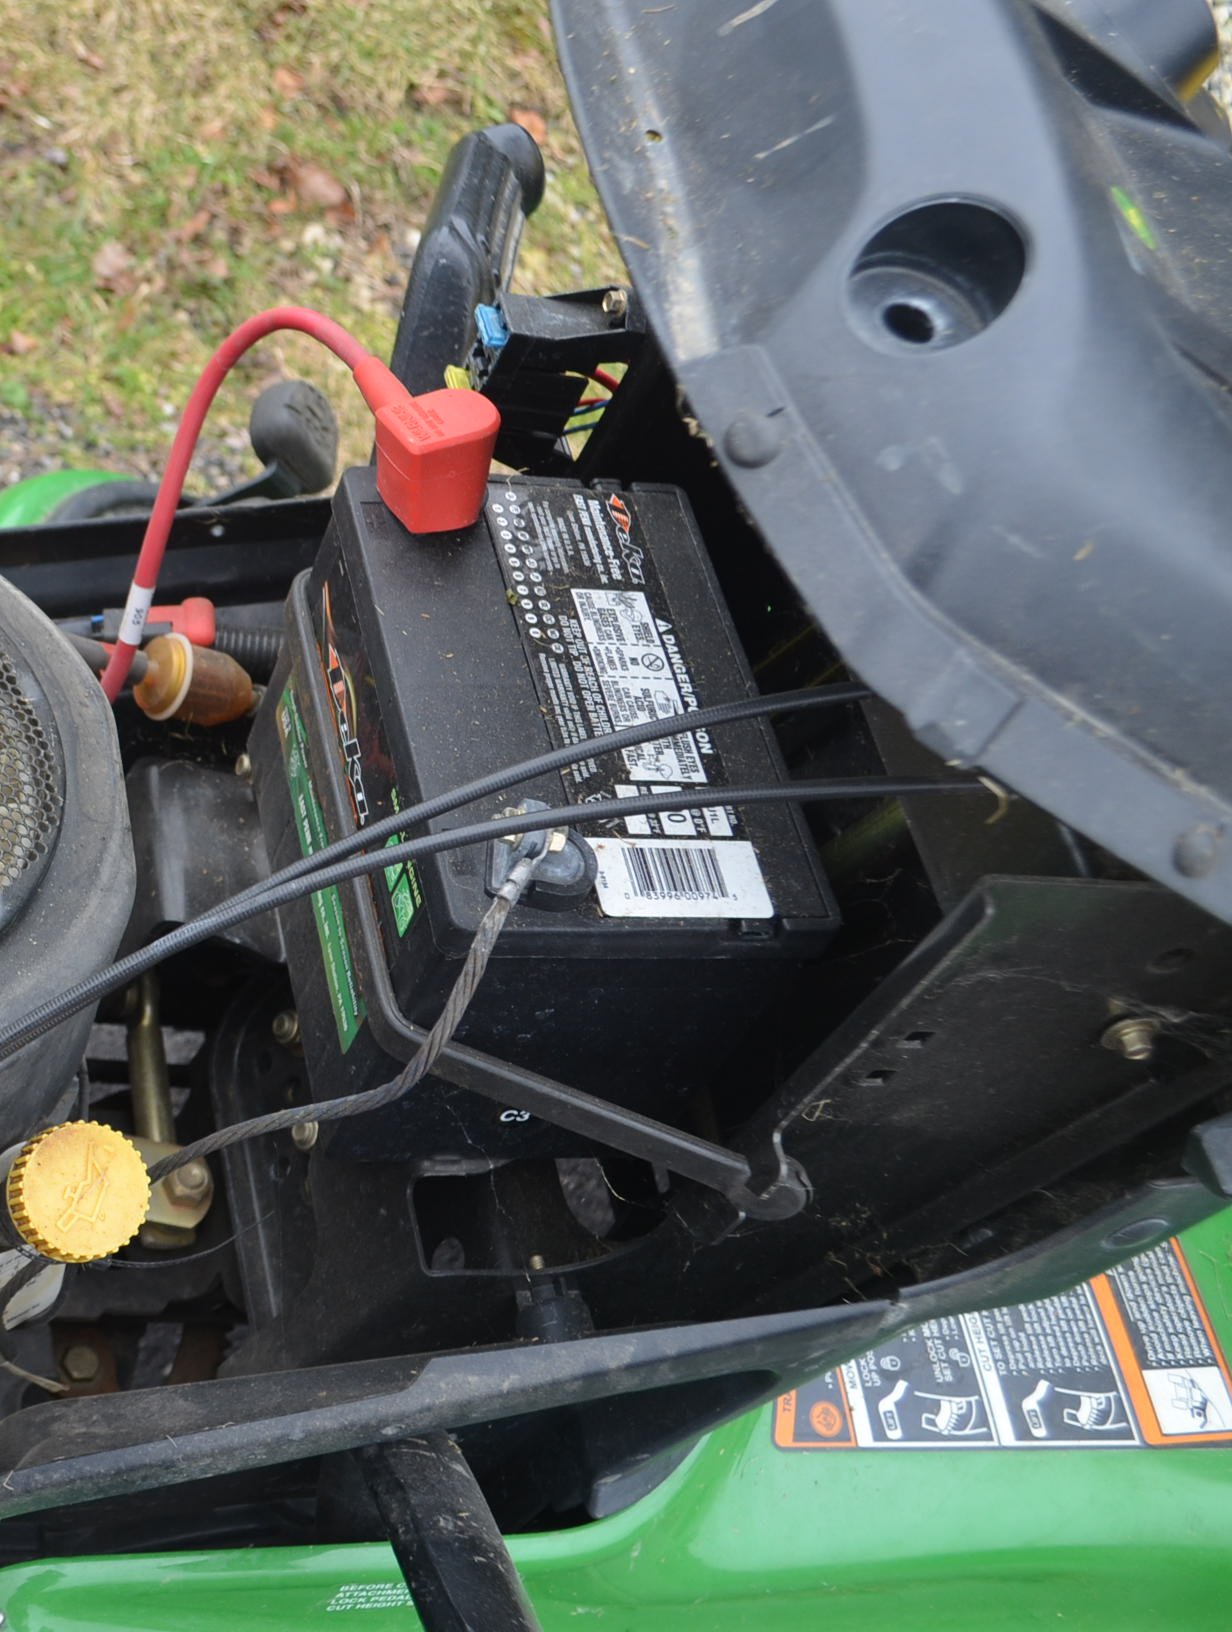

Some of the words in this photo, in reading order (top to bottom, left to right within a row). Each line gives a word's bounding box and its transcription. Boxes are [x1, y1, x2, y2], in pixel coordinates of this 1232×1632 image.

[588, 500, 621, 579] Maintenance-Free
[559, 615, 569, 626] DO
[570, 619, 582, 637] KEEP
[597, 608, 610, 627] GASES
[604, 630, 613, 640] CAN
[607, 608, 625, 641] EXPLOSIVE
[563, 628, 574, 642] NOT
[575, 639, 587, 653] OUT
[573, 661, 583, 671] DO
[580, 655, 591, 665] OF
[577, 673, 588, 688] NOT
[584, 666, 598, 691] REACH
[582, 690, 595, 710] OPEN
[592, 693, 603, 702] OF
[622, 687, 631, 699] CAN
[663, 635, 711, 753] DANGER/POON
[634, 696, 645, 711] ACID
[641, 688, 658, 720] SULFURIC
[686, 756, 699, 773] EYES
[646, 892, 681, 900] 83996
[686, 892, 718, 900] 00974
[1120, 1275, 1133, 1299] down
[1142, 1284, 1156, 1309] stops
[1129, 1301, 1141, 1319] and
[1138, 1297, 1154, 1331] sudden
[983, 1318, 995, 1337] CUT
[997, 1323, 1005, 1333] lift
[1009, 1328, 1016, 1338] on
[1025, 1323, 1033, 1333] lift
[1060, 1320, 1068, 1331] lift
[1070, 1321, 1081, 1342] down
[1137, 1321, 1146, 1333] up
[1153, 1312, 1171, 1350] machine
[934, 1339, 946, 1359] CUT
[990, 1341, 1002, 1359] SET
[1013, 1340, 1020, 1351] up
[1018, 1332, 1029, 1350] hold
[1047, 1336, 1055, 1346] lift
[1053, 1326, 1067, 1356] desired
[1066, 1333, 1080, 1366] Depress
[1143, 1335, 1155, 1359] Drive
[1150, 1333, 1165, 1359] Avoid
[1171, 1335, 1183, 1358] Keep
[1178, 1334, 1192, 1357] Read
[978, 1348, 992, 1371] CUT
[1002, 1336, 1016, 1369] Depress
[1025, 1352, 1035, 1368] and
[1030, 1336, 1043, 1368] Release
[1039, 1336, 1052, 1367] Release
[1052, 1348, 1062, 1366] Turn
[1078, 1345, 1089, 1366] Push
[926, 1340, 943, 1382] UNLOCK
[997, 1361, 1007, 1375] TO
[1016, 1353, 1026, 1369] Pull
[859, 1359, 872, 1386] LOCK
[871, 1372, 881, 1386] UP
[941, 1363, 952, 1381] SET
[340, 1583, 392, 1591] BEFORE
[356, 1601, 403, 1609] HEIGHT
